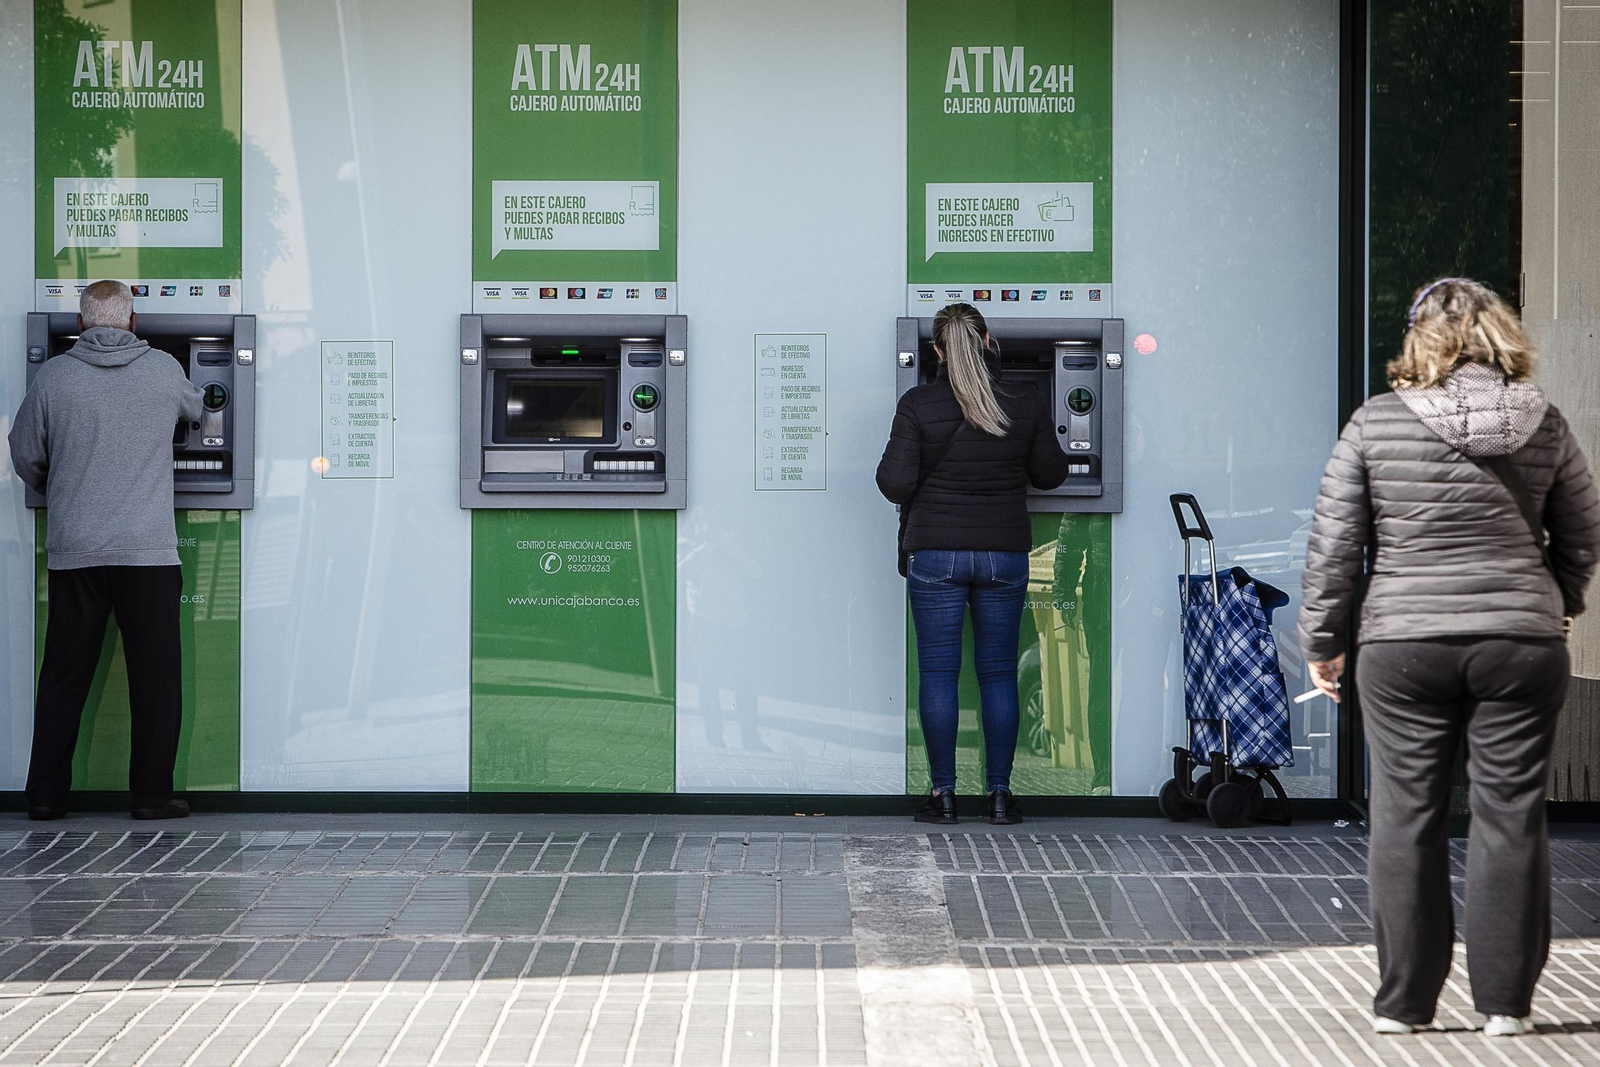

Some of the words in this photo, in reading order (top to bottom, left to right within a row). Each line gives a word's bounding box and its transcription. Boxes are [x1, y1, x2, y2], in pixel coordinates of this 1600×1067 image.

[72, 40, 154, 88] ATM
[158, 60, 204, 88] 24H
[510, 44, 591, 91] ATM
[595, 64, 640, 92] 24H
[944, 46, 1025, 94] ATM
[1028, 65, 1074, 93] 24H
[72, 92, 120, 108] CAJERO
[122, 89, 205, 108] AUTOMÁTICO
[510, 94, 558, 112] CAJERO
[560, 92, 642, 112] AUTOMÁTICO
[944, 97, 991, 114] CAJERO
[994, 94, 1076, 114] AUTOMÁTICO
[66, 194, 80, 206] EN
[82, 194, 108, 206] ESTE
[110, 194, 149, 206] CAJERO
[504, 196, 518, 209] EN
[520, 196, 546, 209] ESTE
[548, 196, 586, 209] CAJERO
[938, 198, 952, 211] EN
[954, 198, 978, 211] ESTE
[982, 198, 1020, 211] CAJERO
[66, 209, 106, 222] PUEDES
[108, 209, 142, 222] PAGAR
[146, 209, 188, 222] RECIBOS
[504, 212, 544, 224] PUEDES
[546, 212, 580, 224] PAGAR
[582, 212, 625, 224] RECIBOS
[938, 214, 977, 227] PUEDES
[980, 214, 1014, 227] HACER
[66, 224, 74, 238] Y
[76, 224, 116, 238] MULTAS
[504, 227, 512, 240] Y
[514, 227, 554, 240] MULTAS
[938, 230, 990, 242] INGRESOS
[990, 230, 1004, 242] EN
[1006, 230, 1054, 242] EFECTIVO
[516, 541, 545, 550] CENTRO
[547, 541, 556, 550] DE
[558, 539, 594, 550] ATENCIÓN
[595, 541, 603, 550] AL
[605, 541, 632, 550] CLIENTE
[568, 564, 611, 572] 952076263
[507, 596, 640, 608] www.unicajabanco.es
